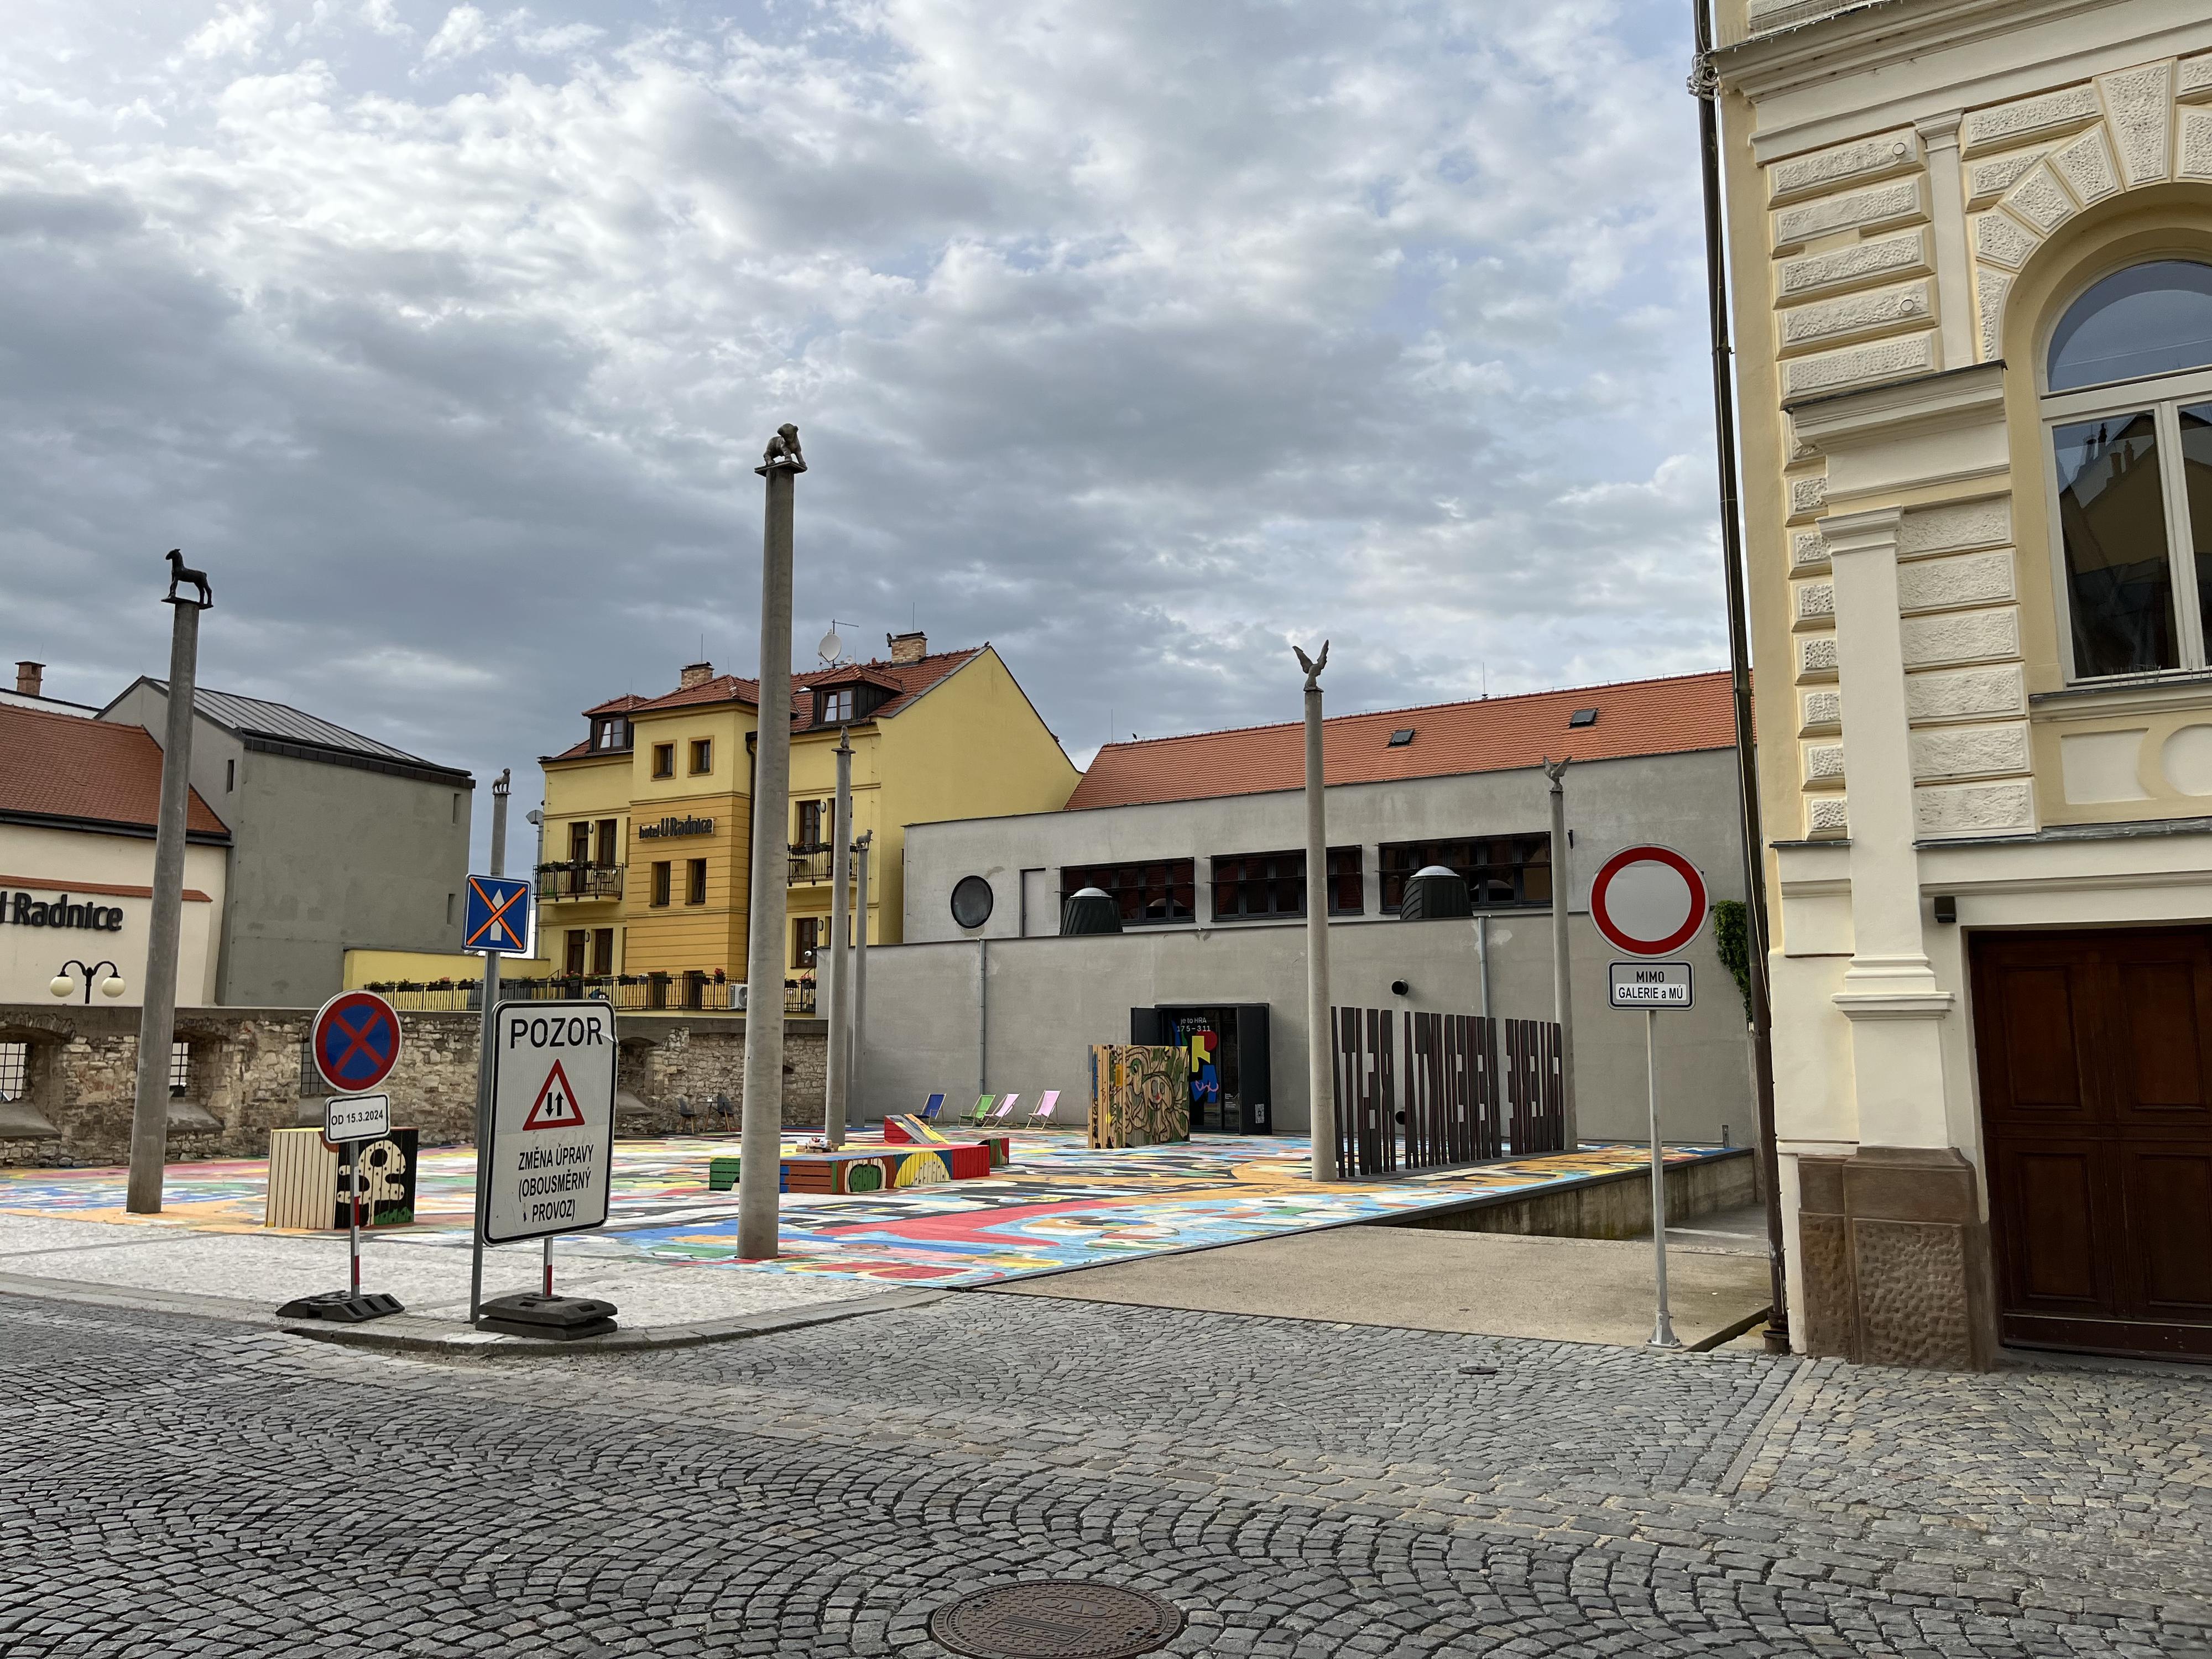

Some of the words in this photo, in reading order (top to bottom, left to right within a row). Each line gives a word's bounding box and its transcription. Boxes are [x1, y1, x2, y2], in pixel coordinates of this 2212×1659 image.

[639, 824, 659, 839] hotel
[661, 818, 669, 836] U
[670, 815, 712, 836] Radnice
[14, 892, 123, 931] Radnice
[1636, 971, 1665, 983] MIMO
[1619, 987, 1658, 998] GALERIE
[1661, 990, 1666, 999] a
[1669, 985, 1683, 999] MÚ
[510, 1017, 603, 1049] POZOR
[331, 1115, 343, 1125] OD
[346, 1109, 383, 1124] 15.3.2024
[518, 1146, 553, 1171] ZMĚNA
[556, 1143, 594, 1166] ÚPRAVY
[519, 1166, 591, 1203] (OBOUSMĚRNÝ
[532, 1199, 575, 1223] PROVOZ)
